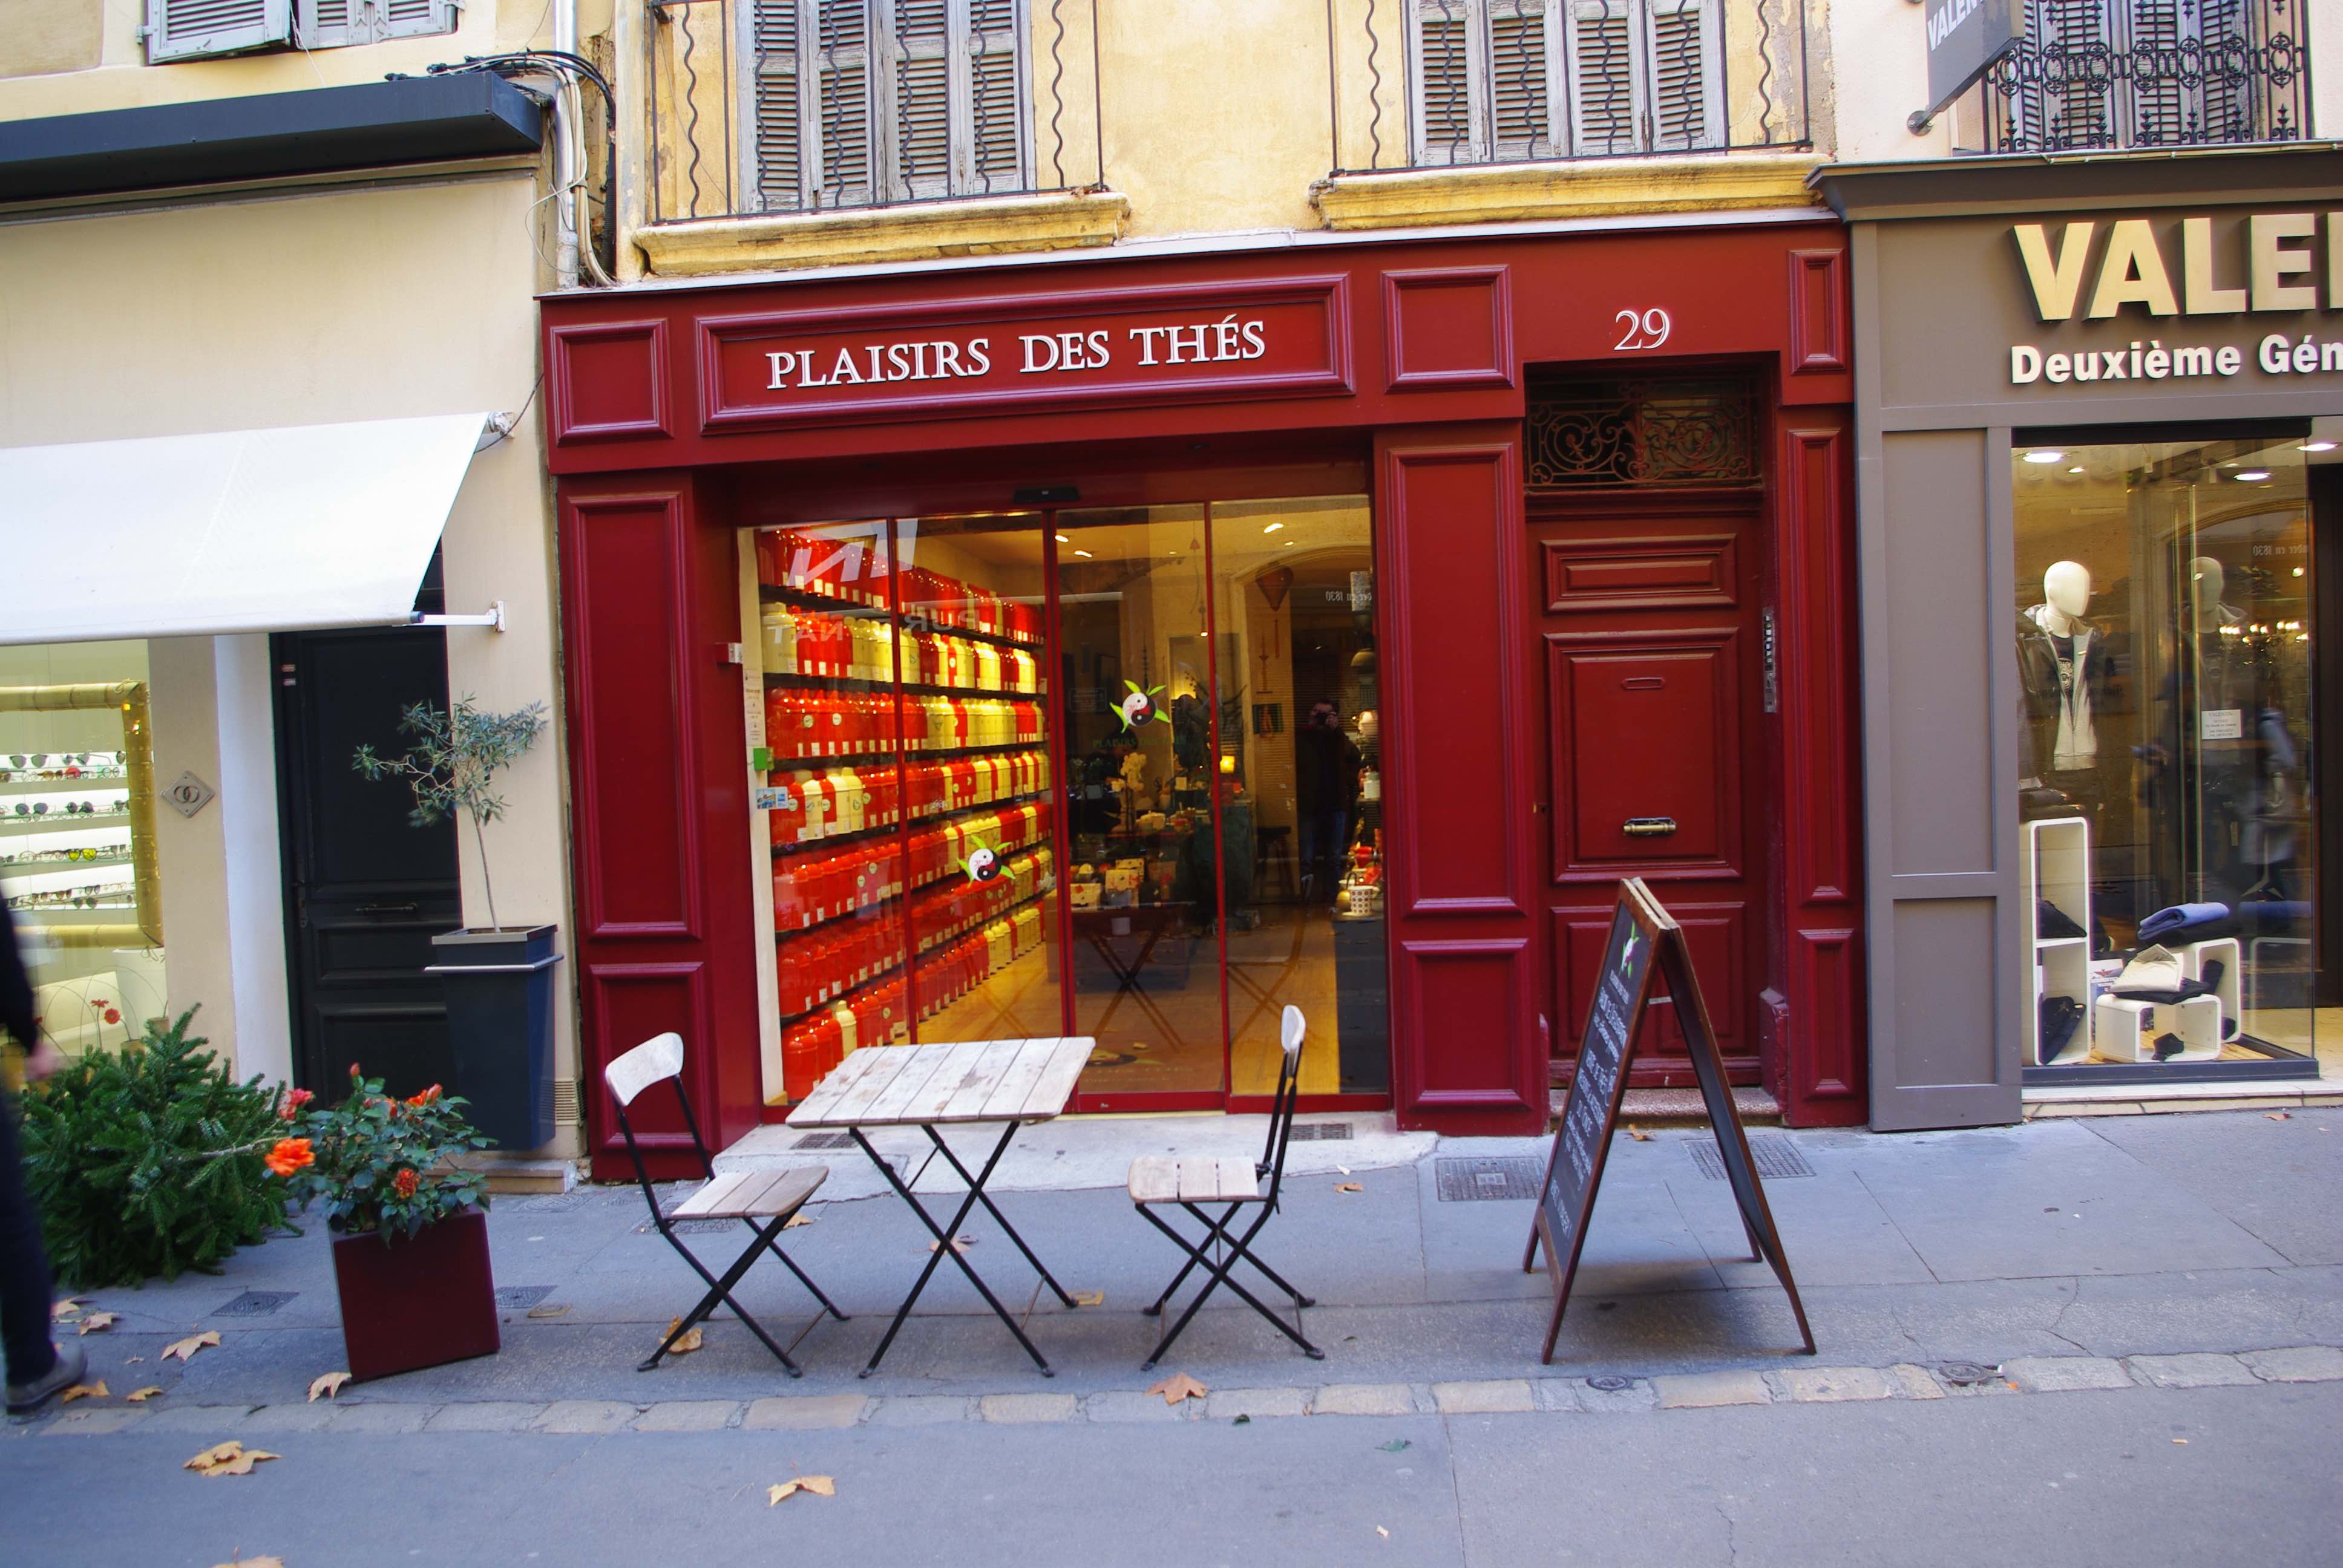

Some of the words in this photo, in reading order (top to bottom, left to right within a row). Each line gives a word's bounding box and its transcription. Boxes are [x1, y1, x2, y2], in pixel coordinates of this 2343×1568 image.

[2013, 212, 2343, 321] VALE
[765, 338, 991, 390] PLAISIRS
[1018, 330, 1110, 373] DES
[1129, 313, 1266, 365] THÉS
[1614, 308, 1671, 351] 29
[2011, 340, 2241, 384] Deuxième
